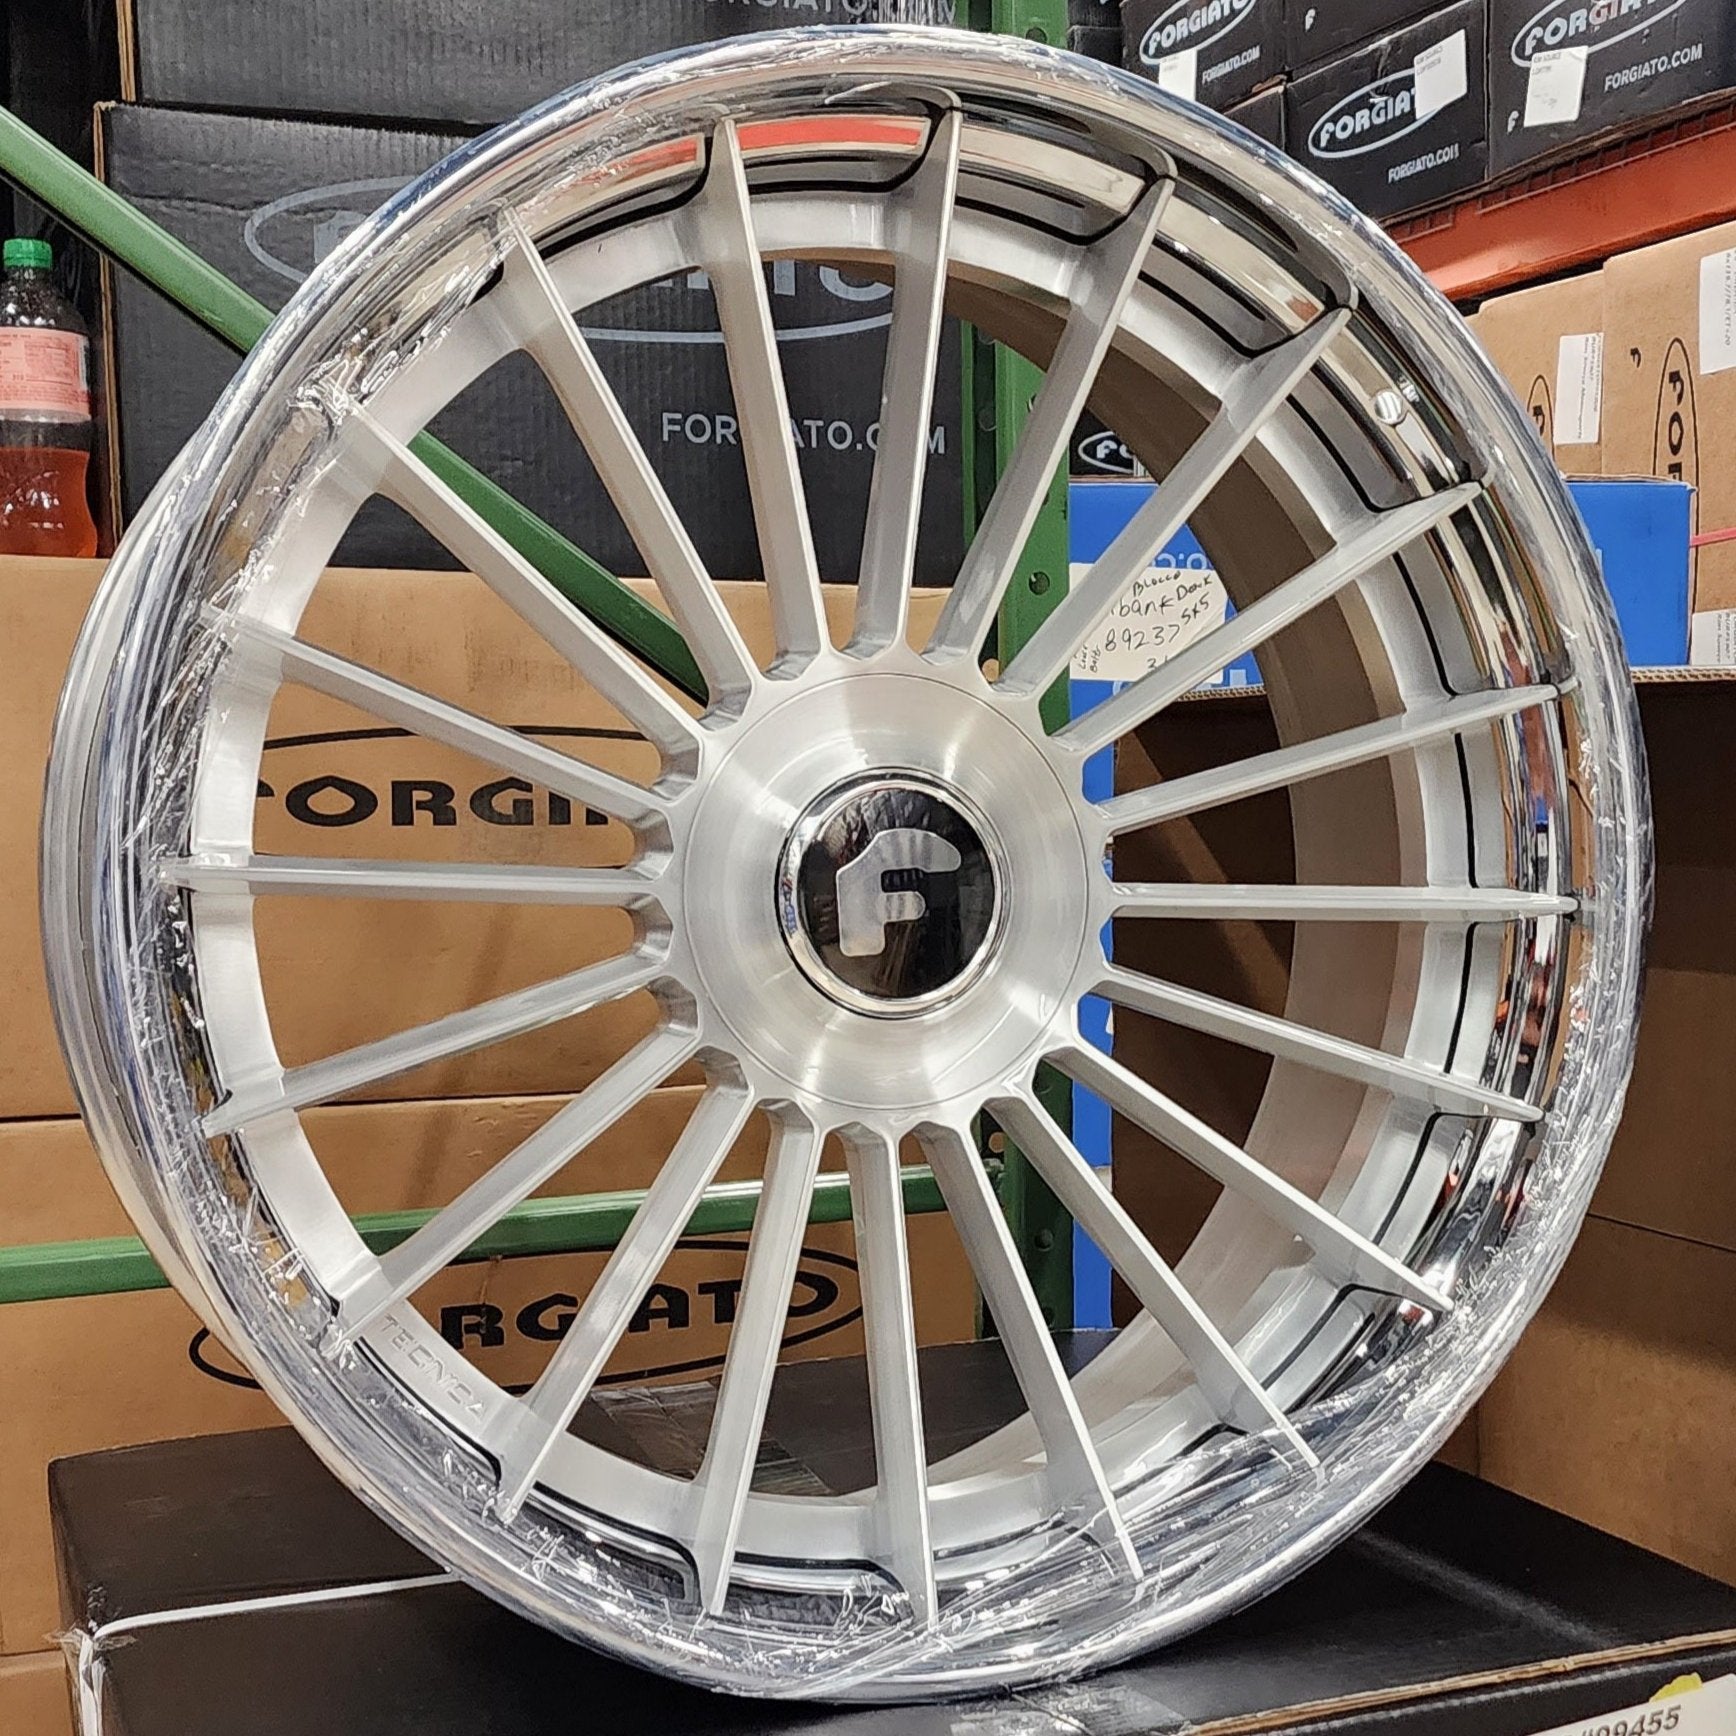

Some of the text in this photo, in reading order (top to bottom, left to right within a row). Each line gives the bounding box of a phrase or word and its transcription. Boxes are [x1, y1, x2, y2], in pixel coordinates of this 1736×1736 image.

[1202, 45, 1261, 85] FORGIATO.COM
[1603, 43, 1703, 94] FORGIATO.COM
[1388, 143, 1459, 183] FORGIATO.COM
[1104, 623, 1180, 652] 89237
[258, 775, 608, 827] ORGI
